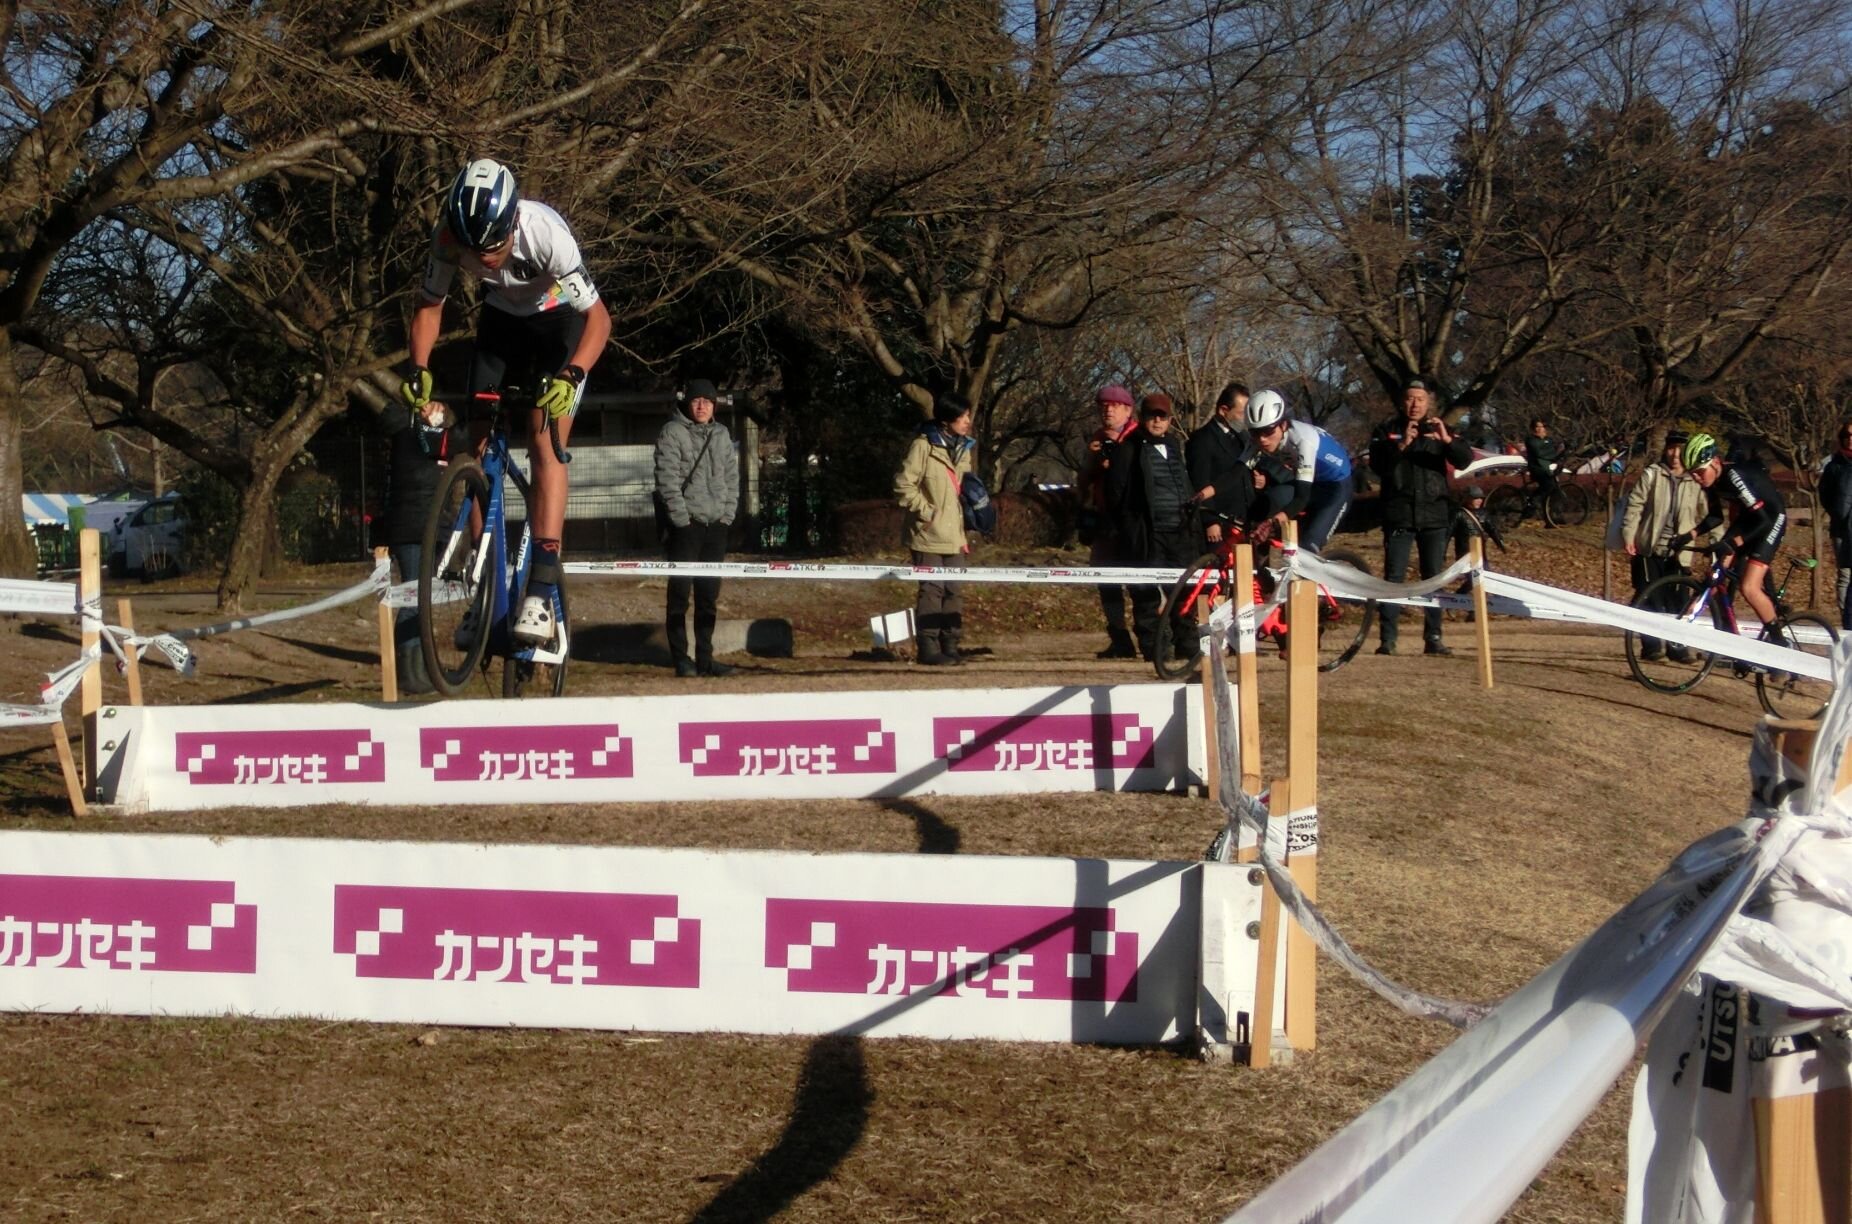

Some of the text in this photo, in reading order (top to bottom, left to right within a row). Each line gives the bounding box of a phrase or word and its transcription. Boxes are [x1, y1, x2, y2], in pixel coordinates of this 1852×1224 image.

[568, 282, 581, 299] 3
[233, 753, 328, 785] カンセキ
[478, 749, 575, 781] カンセキ
[738, 744, 837, 776] カンセキ
[994, 739, 1093, 771] カンセキ
[434, 929, 598, 986] カンセキ
[867, 943, 1034, 1000] カンセキ
